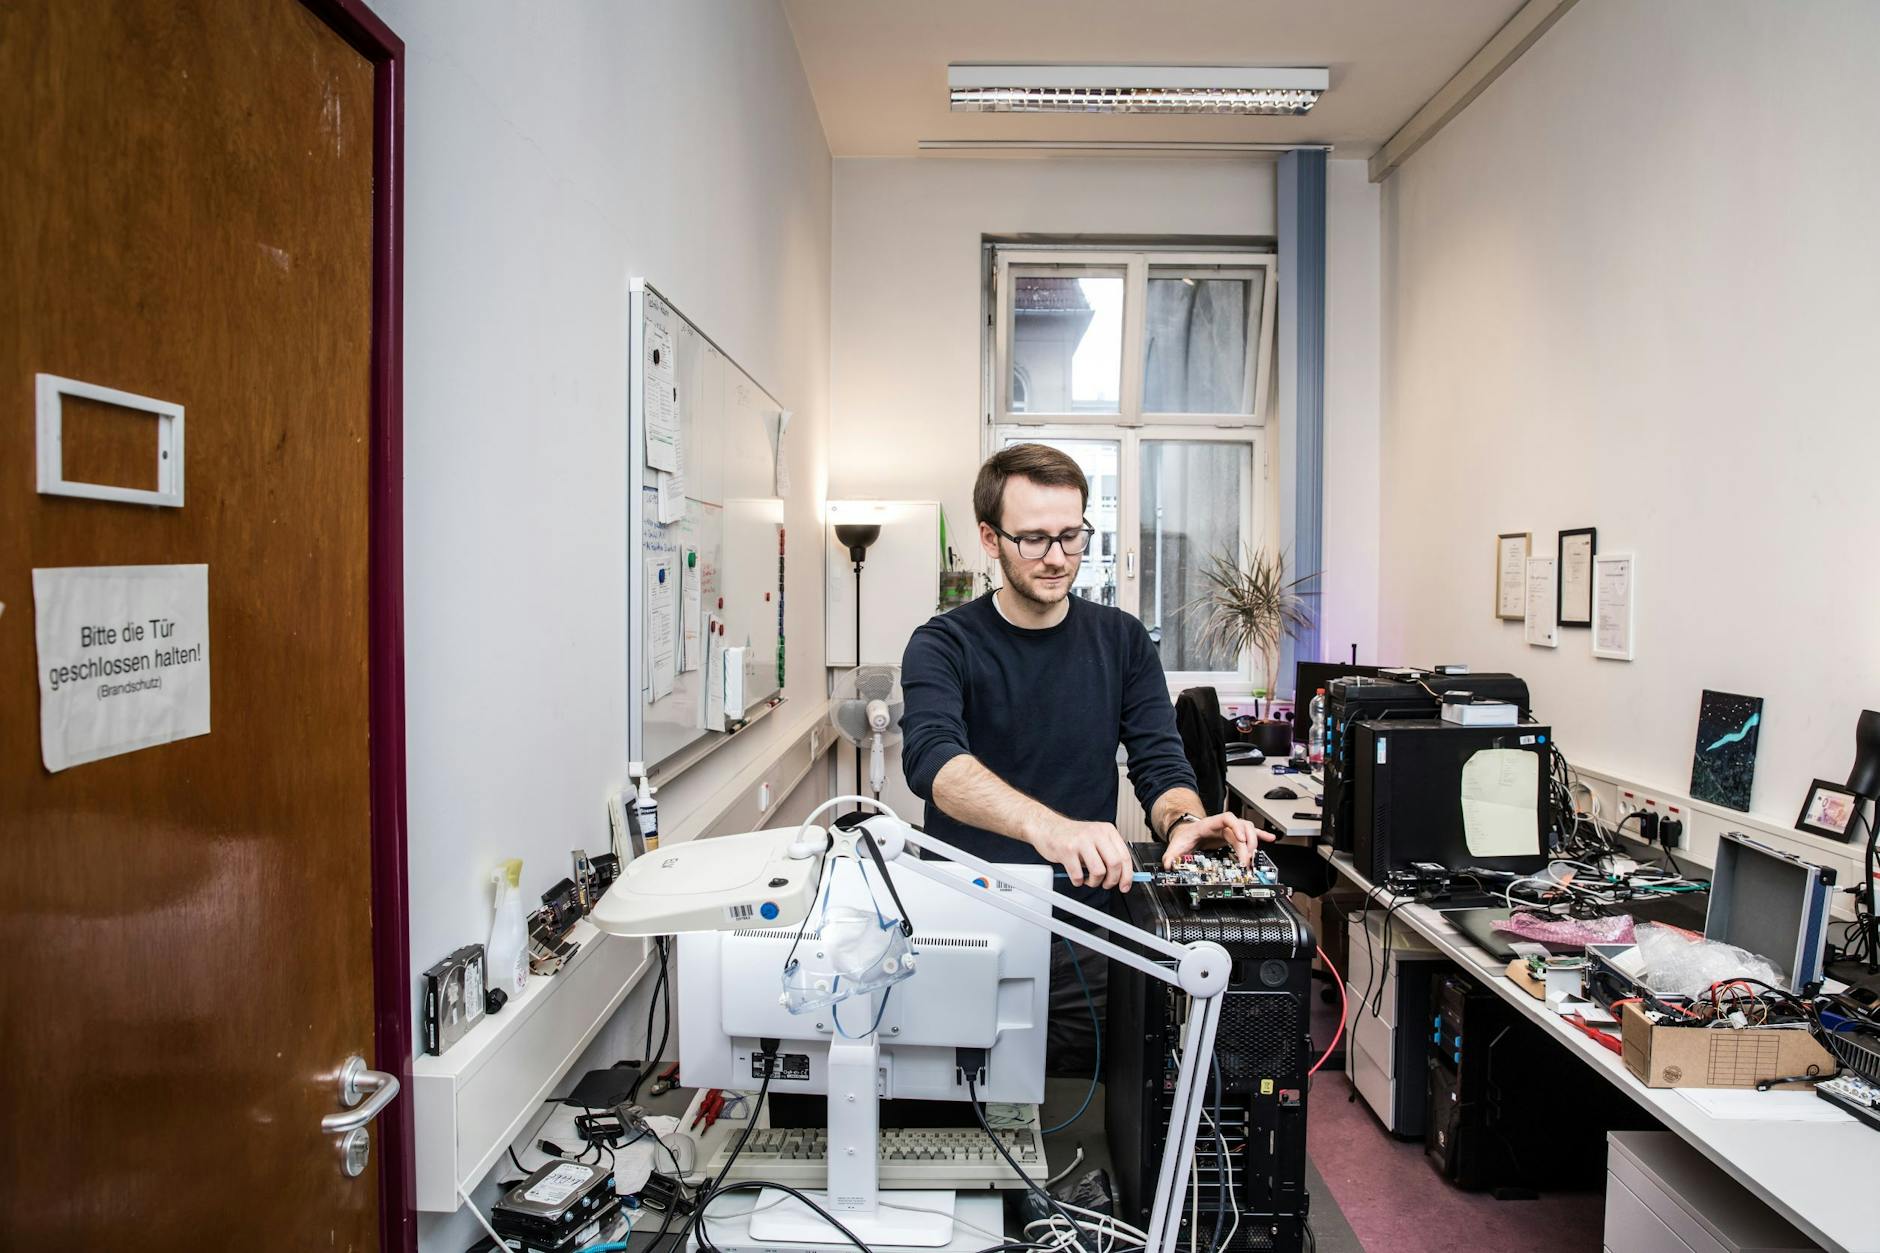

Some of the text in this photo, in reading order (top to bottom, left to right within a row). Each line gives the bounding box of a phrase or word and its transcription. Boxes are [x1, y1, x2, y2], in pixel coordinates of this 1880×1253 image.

[80, 619, 176, 648] Bitte die Tür
[49, 643, 202, 691] geschlossen halten!
[97, 676, 162, 700] (Brandschutz)
